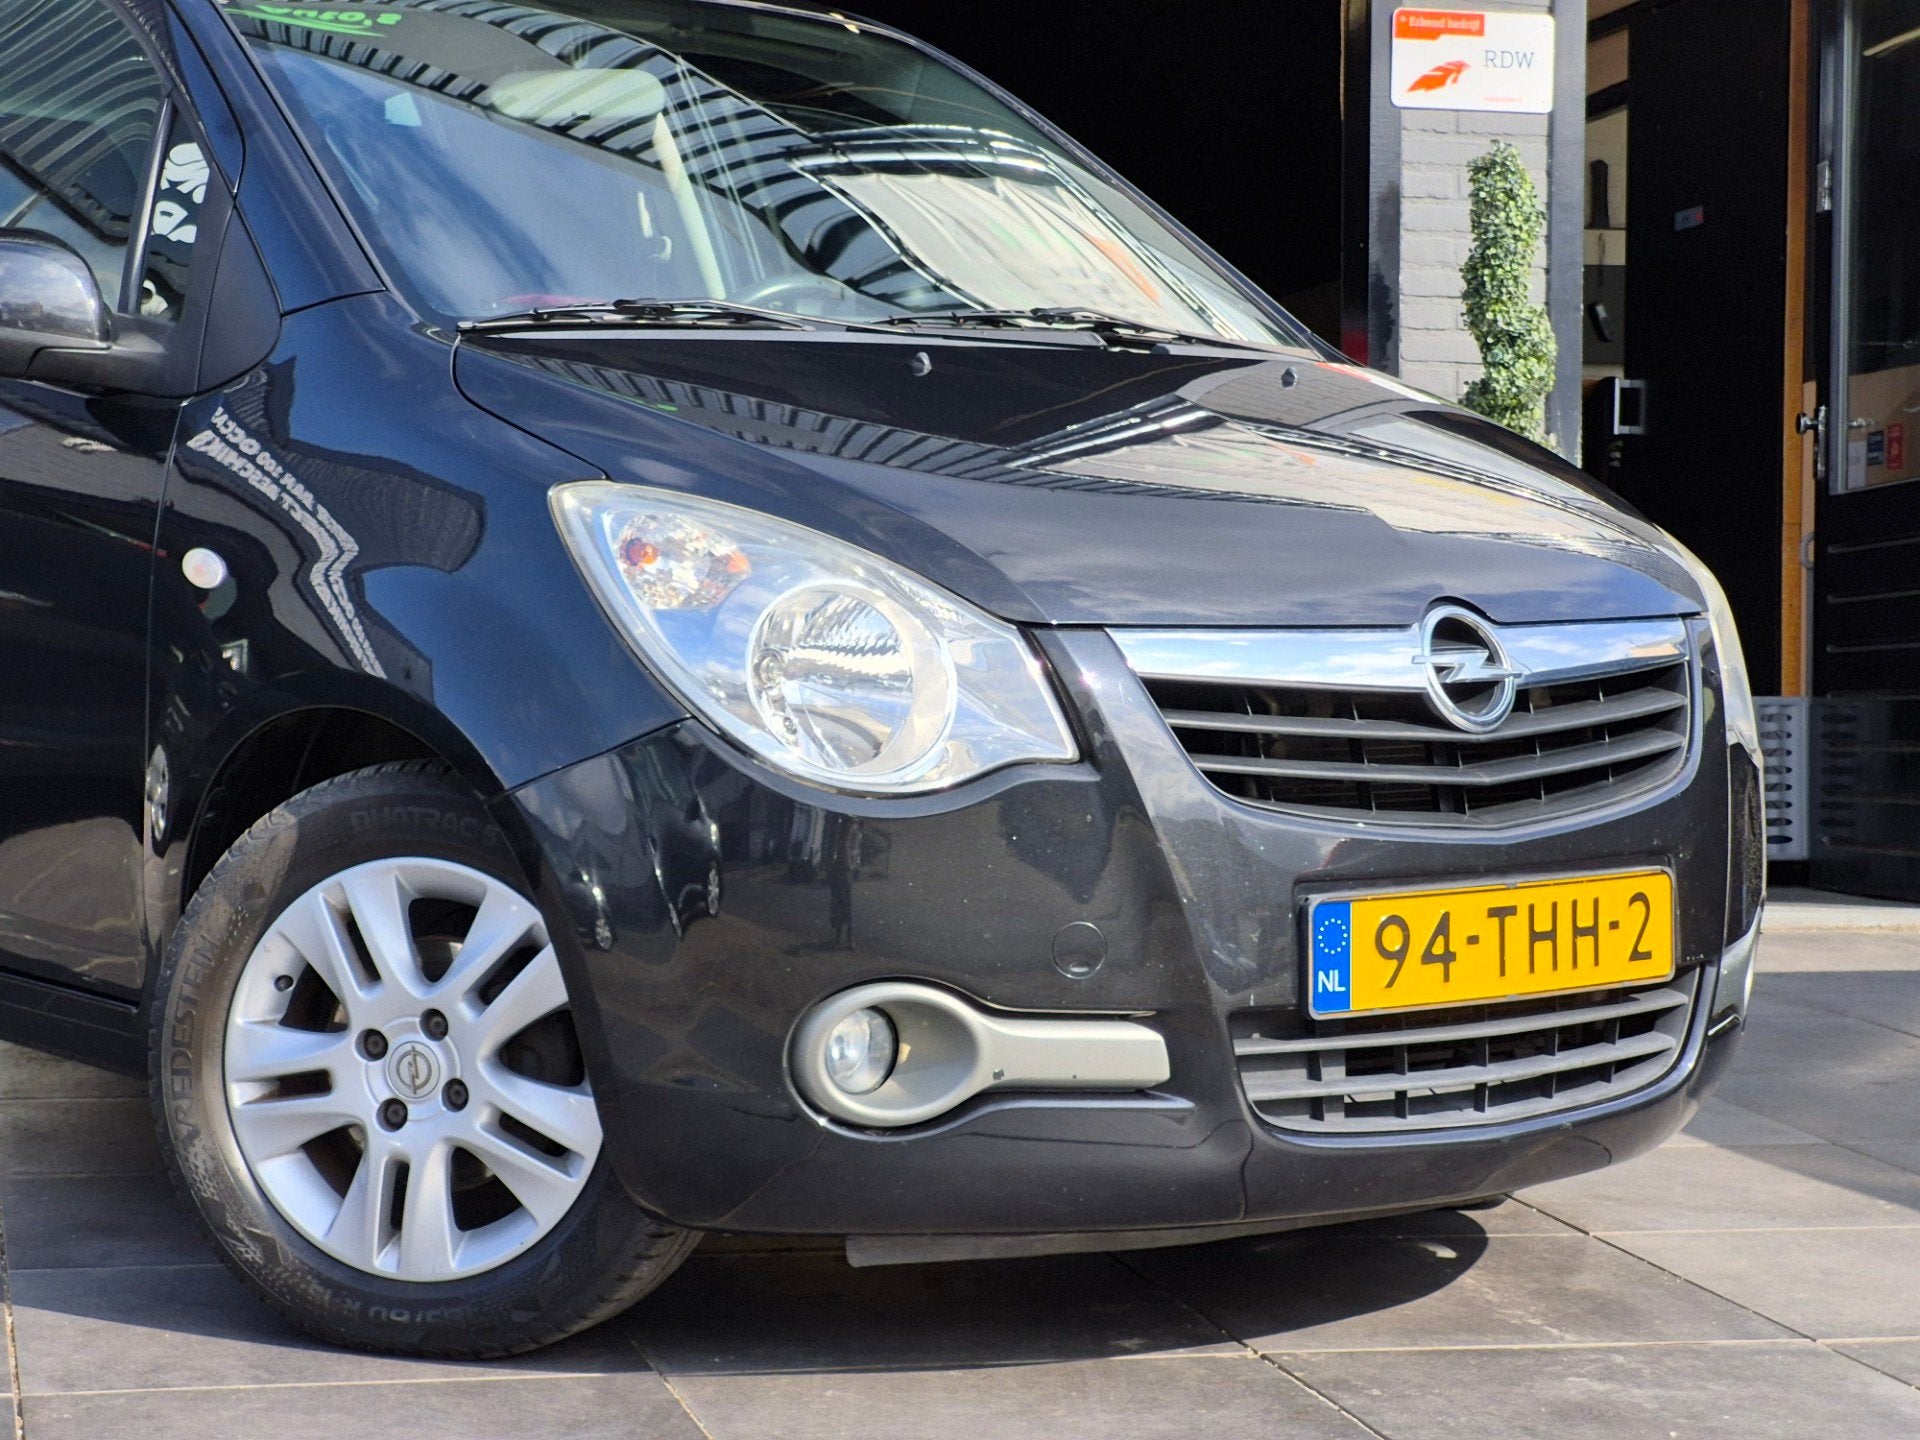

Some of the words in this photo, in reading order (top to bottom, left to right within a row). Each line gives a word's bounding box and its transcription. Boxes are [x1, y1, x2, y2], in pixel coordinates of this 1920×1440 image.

[1409, 16, 1446, 28] Erkend
[1447, 17, 1481, 32] bedrijf
[1485, 50, 1535, 69] RDW
[1374, 891, 1653, 989] 94-THH-2
[1318, 970, 1346, 993] NL
